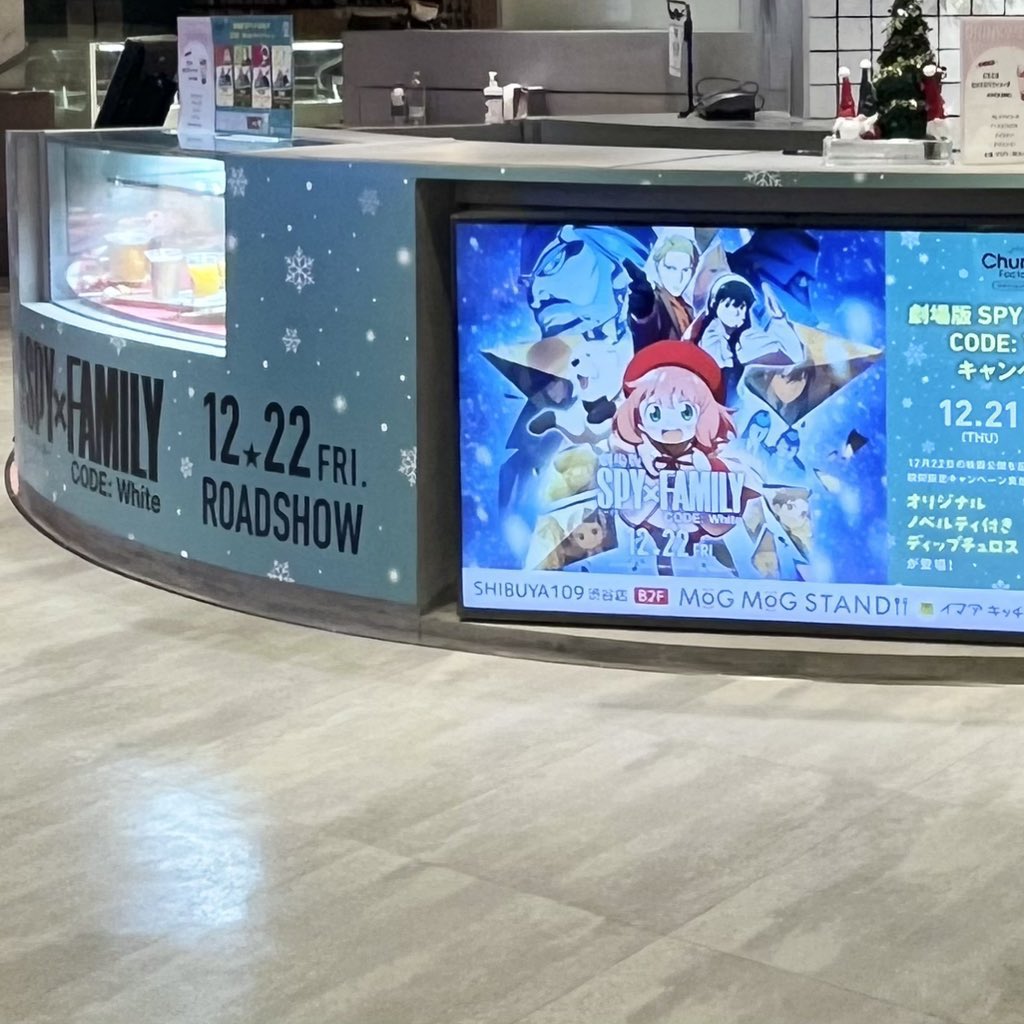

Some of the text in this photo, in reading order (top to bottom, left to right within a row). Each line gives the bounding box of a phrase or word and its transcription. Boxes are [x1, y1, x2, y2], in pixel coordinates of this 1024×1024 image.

[908, 303, 972, 326] 劇場版
[950, 332, 1017, 354] CODE:
[318, 443, 368, 488] FRI.
[71, 460, 161, 514] CODE: White
[906, 493, 986, 511] オリジナル
[202, 476, 364, 555] ROADSHOW
[473, 580, 585, 601] SHIBUYA109
[637, 589, 666, 604] B2F
